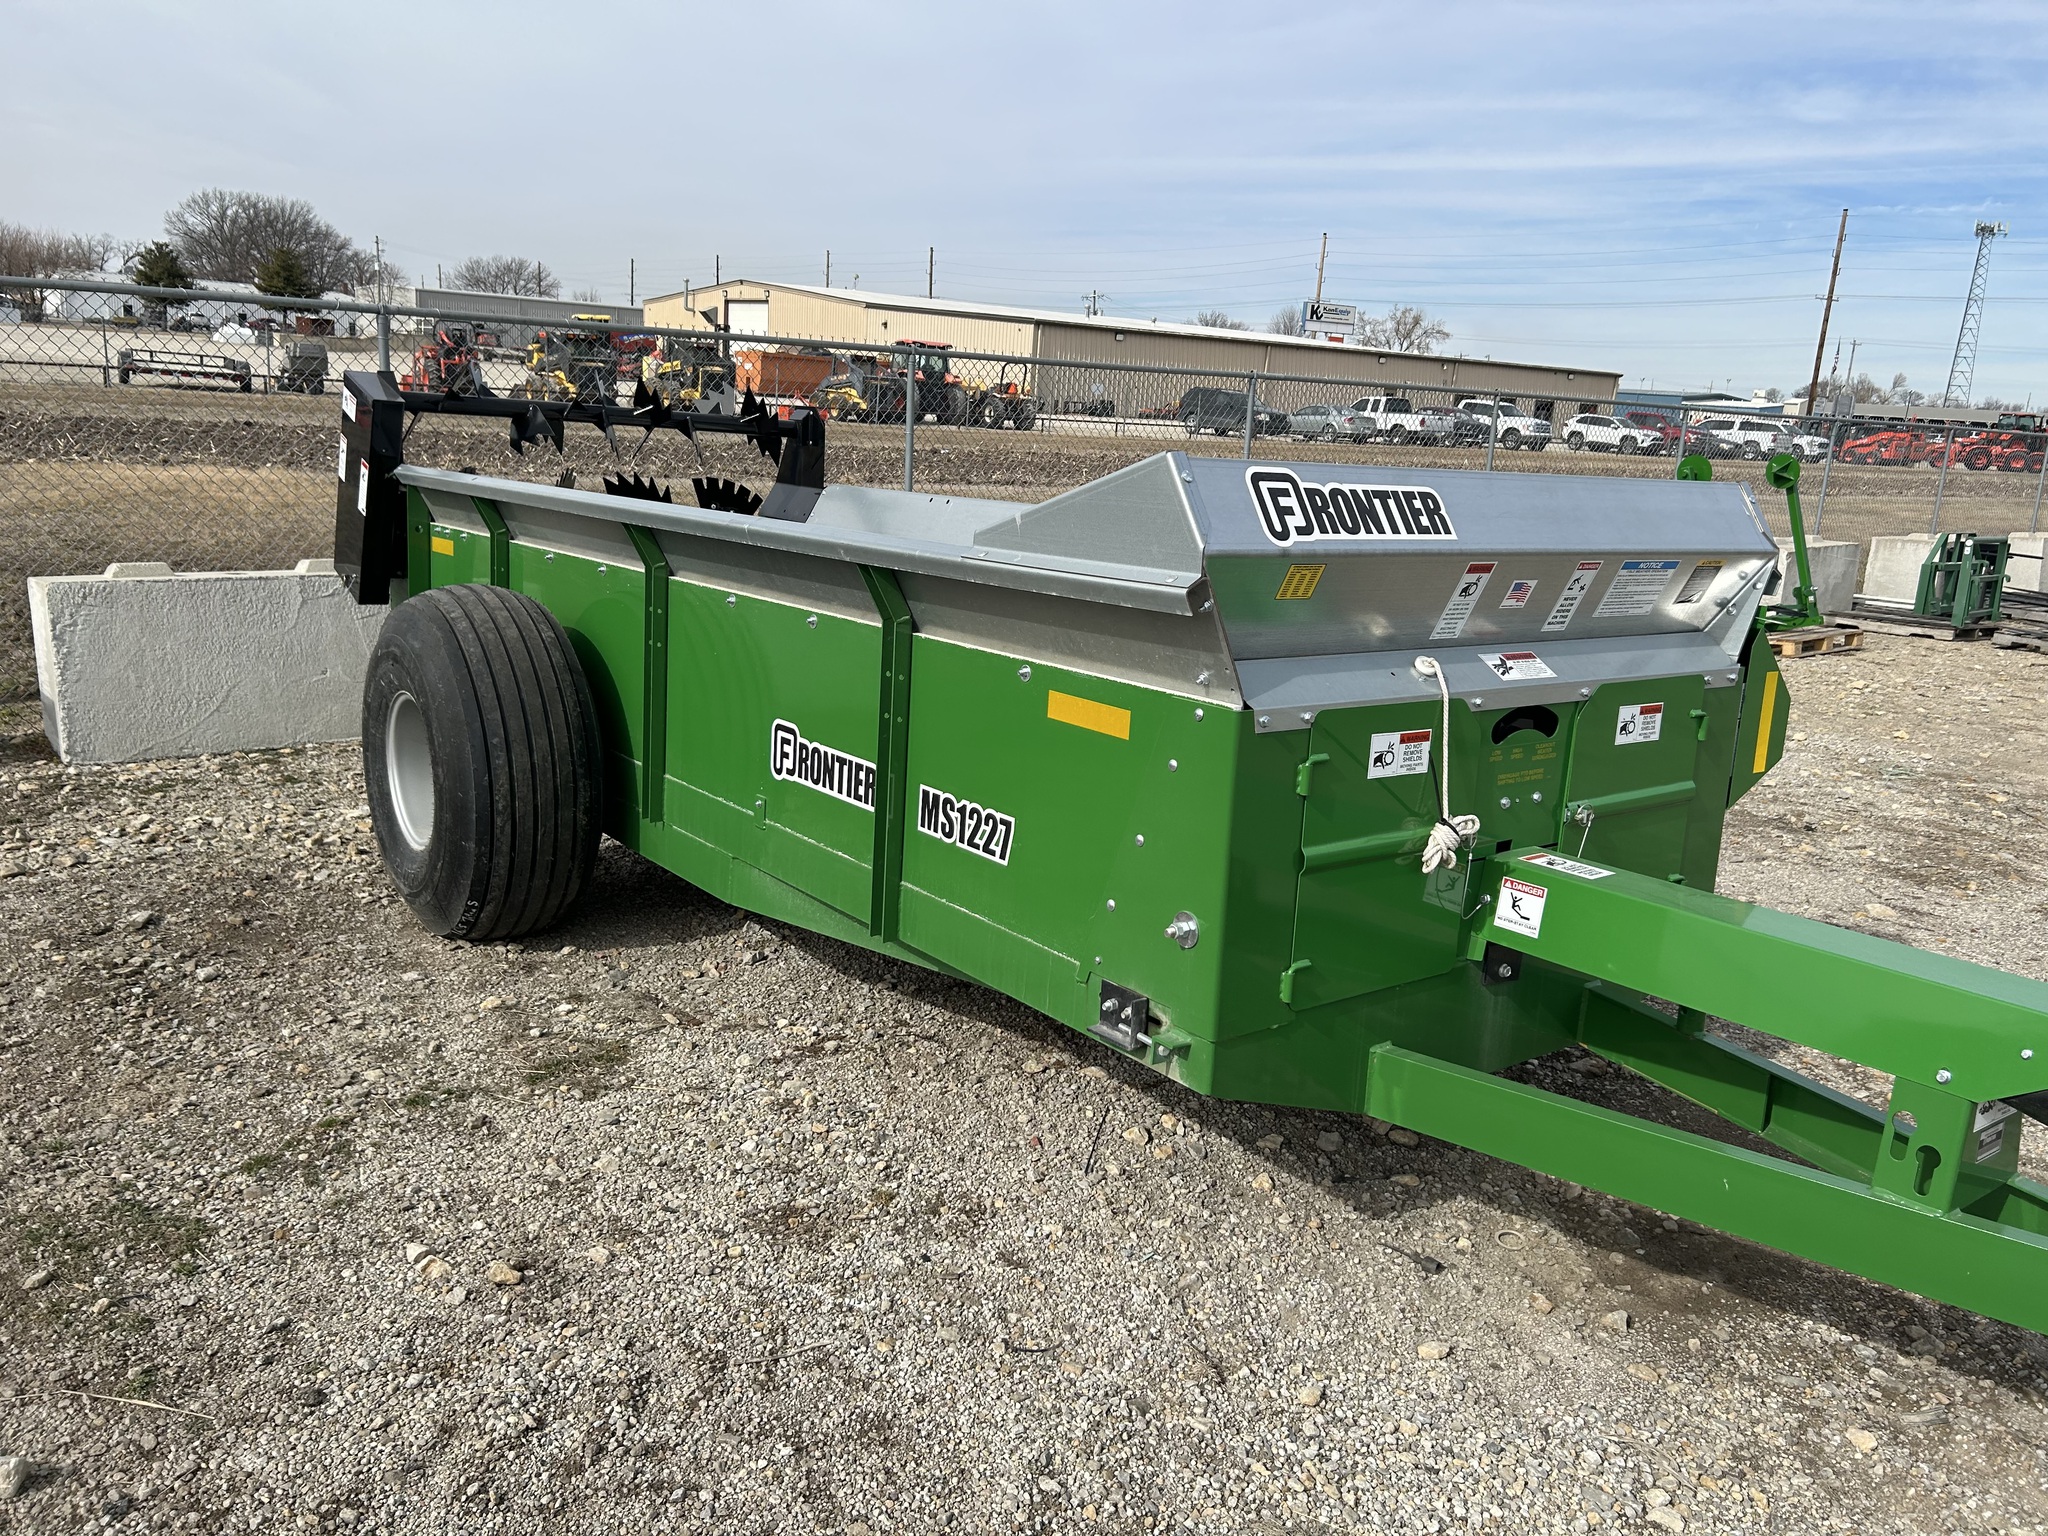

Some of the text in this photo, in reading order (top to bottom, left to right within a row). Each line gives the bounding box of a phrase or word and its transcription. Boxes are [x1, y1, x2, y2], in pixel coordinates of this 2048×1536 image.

[1250, 472, 1452, 541] FRONTIER
[773, 723, 877, 807] FRONTIER
[920, 789, 1012, 861] MS1227
[1513, 882, 1543, 897] DANGER
[1524, 923, 1537, 931] CLEAR
